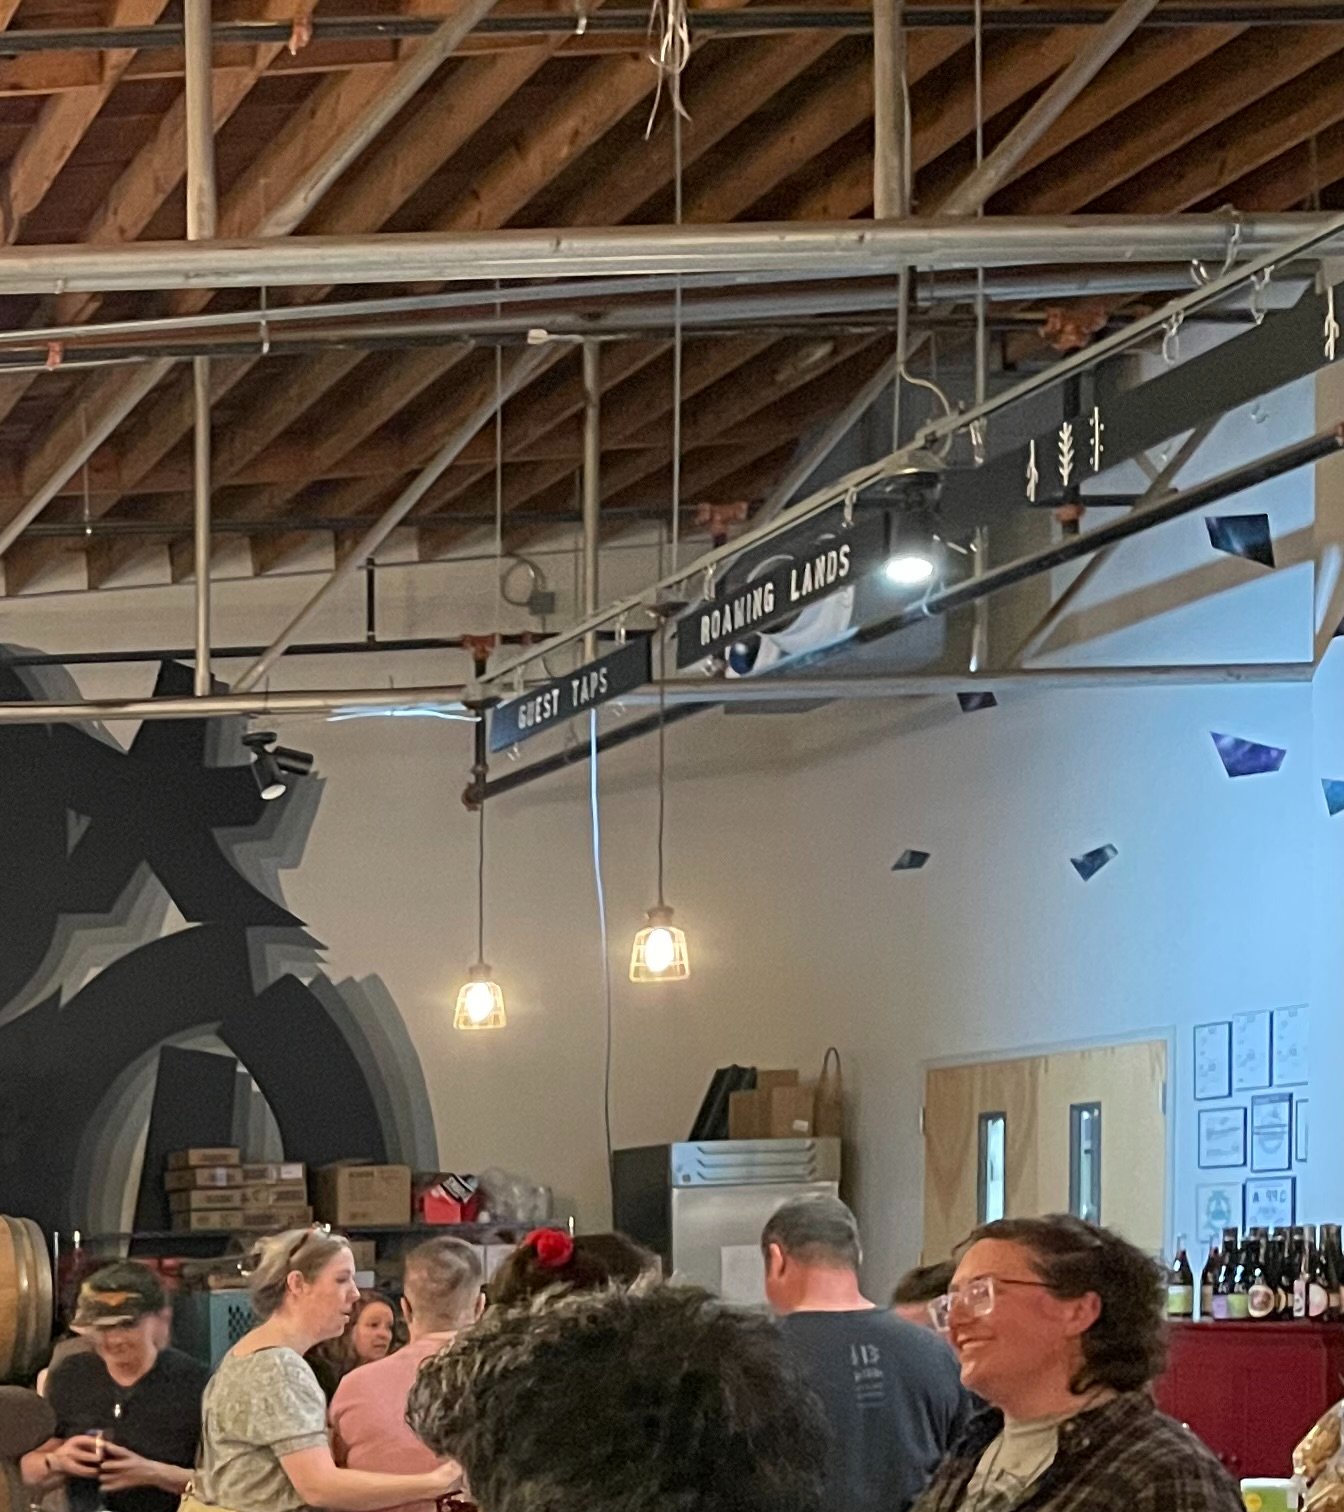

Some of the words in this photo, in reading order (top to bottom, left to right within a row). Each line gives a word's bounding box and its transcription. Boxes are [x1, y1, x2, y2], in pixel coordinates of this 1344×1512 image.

[699, 581, 775, 646] ROAMING
[790, 543, 852, 600] LANDS
[517, 682, 560, 730] GUEST
[571, 666, 609, 709] TAPS
